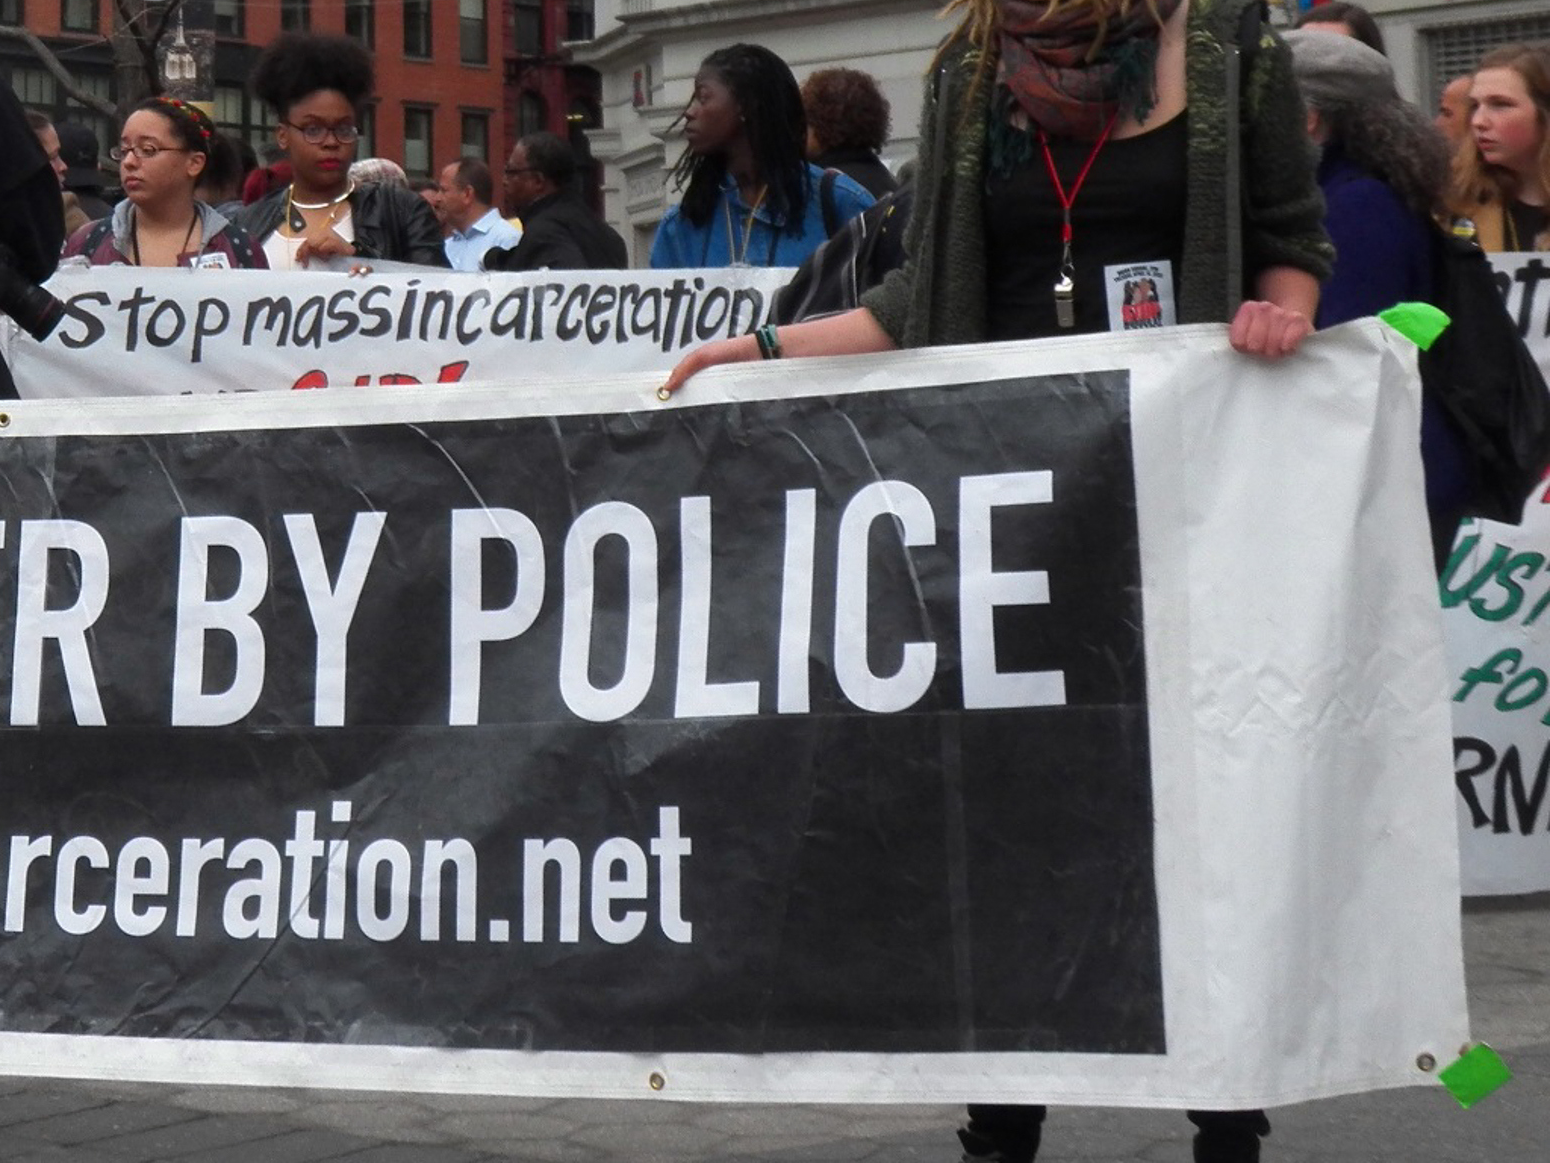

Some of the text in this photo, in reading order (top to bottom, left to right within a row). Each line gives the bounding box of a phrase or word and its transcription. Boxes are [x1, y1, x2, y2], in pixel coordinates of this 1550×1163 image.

[59, 286, 229, 363] Stop
[171, 511, 388, 727] BY
[448, 470, 1067, 727] POLICE
[1452, 647, 1550, 726] fo
